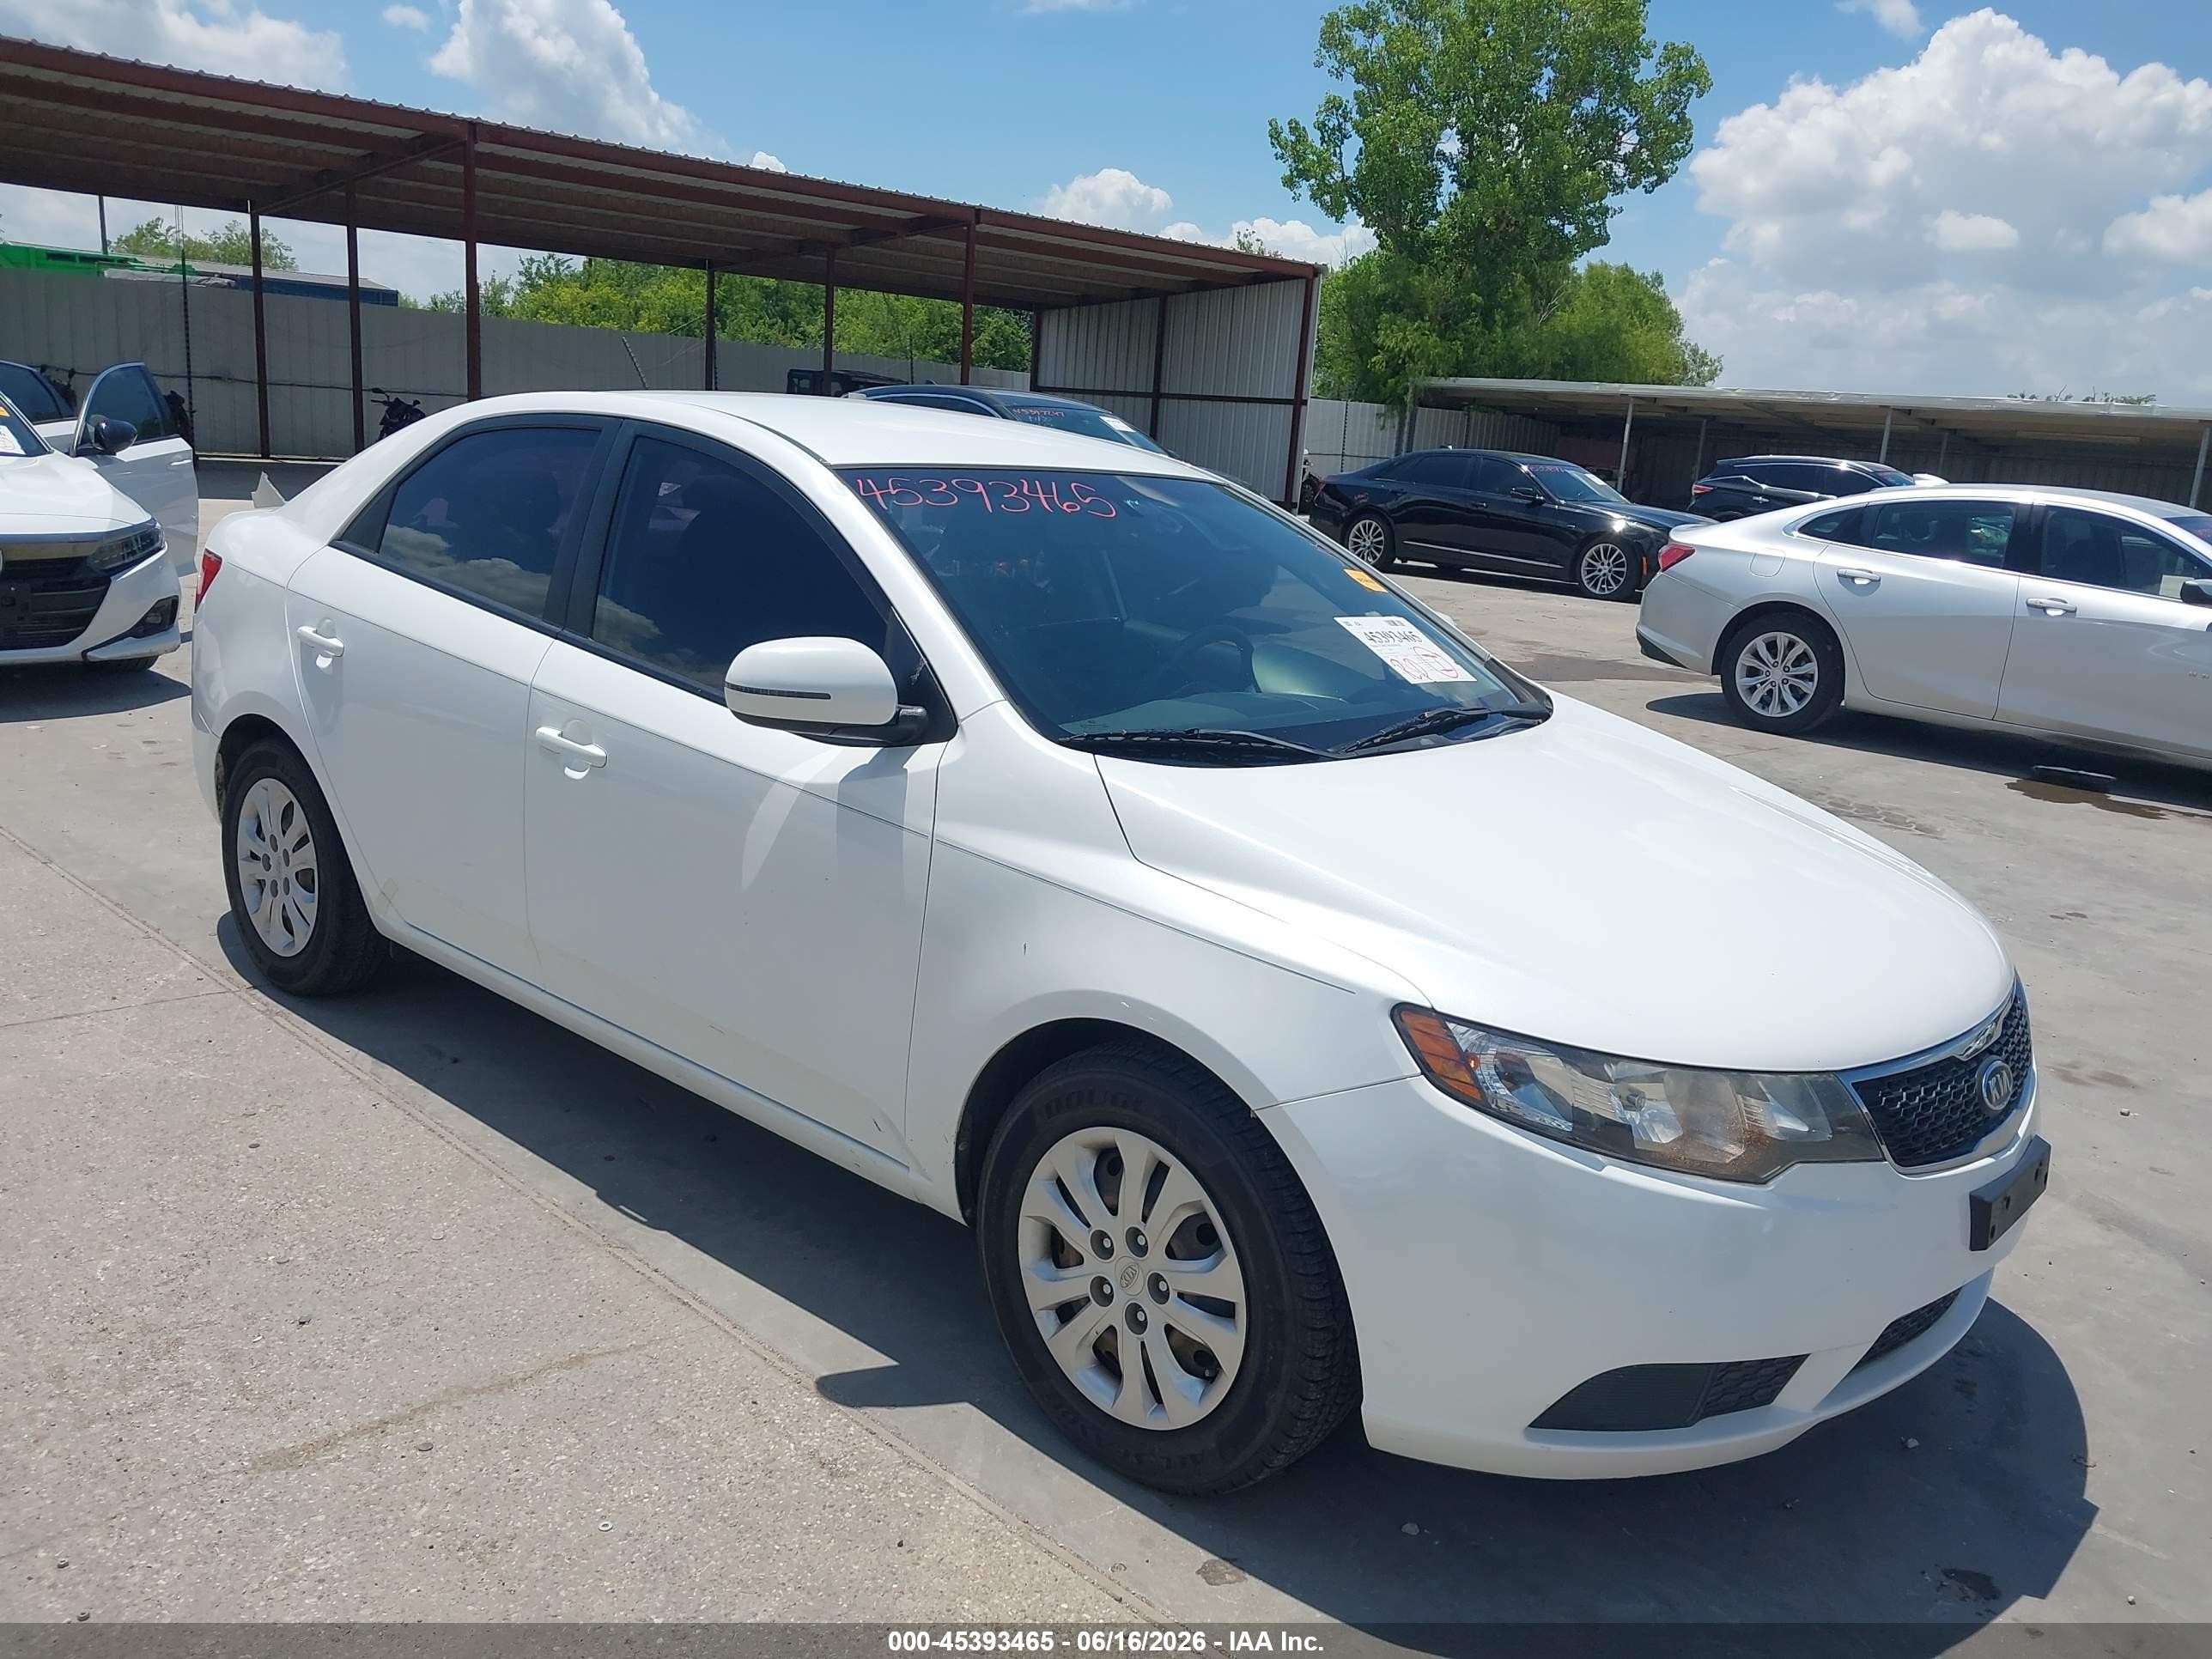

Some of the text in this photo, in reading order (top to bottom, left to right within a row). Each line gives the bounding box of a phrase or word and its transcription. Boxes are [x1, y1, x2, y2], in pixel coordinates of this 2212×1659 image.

[856, 477, 1117, 518] 45393465
[1363, 630, 1424, 644] 45393465
[1988, 1070, 2012, 1102] KIA
[1120, 1265, 1138, 1288] KIA
